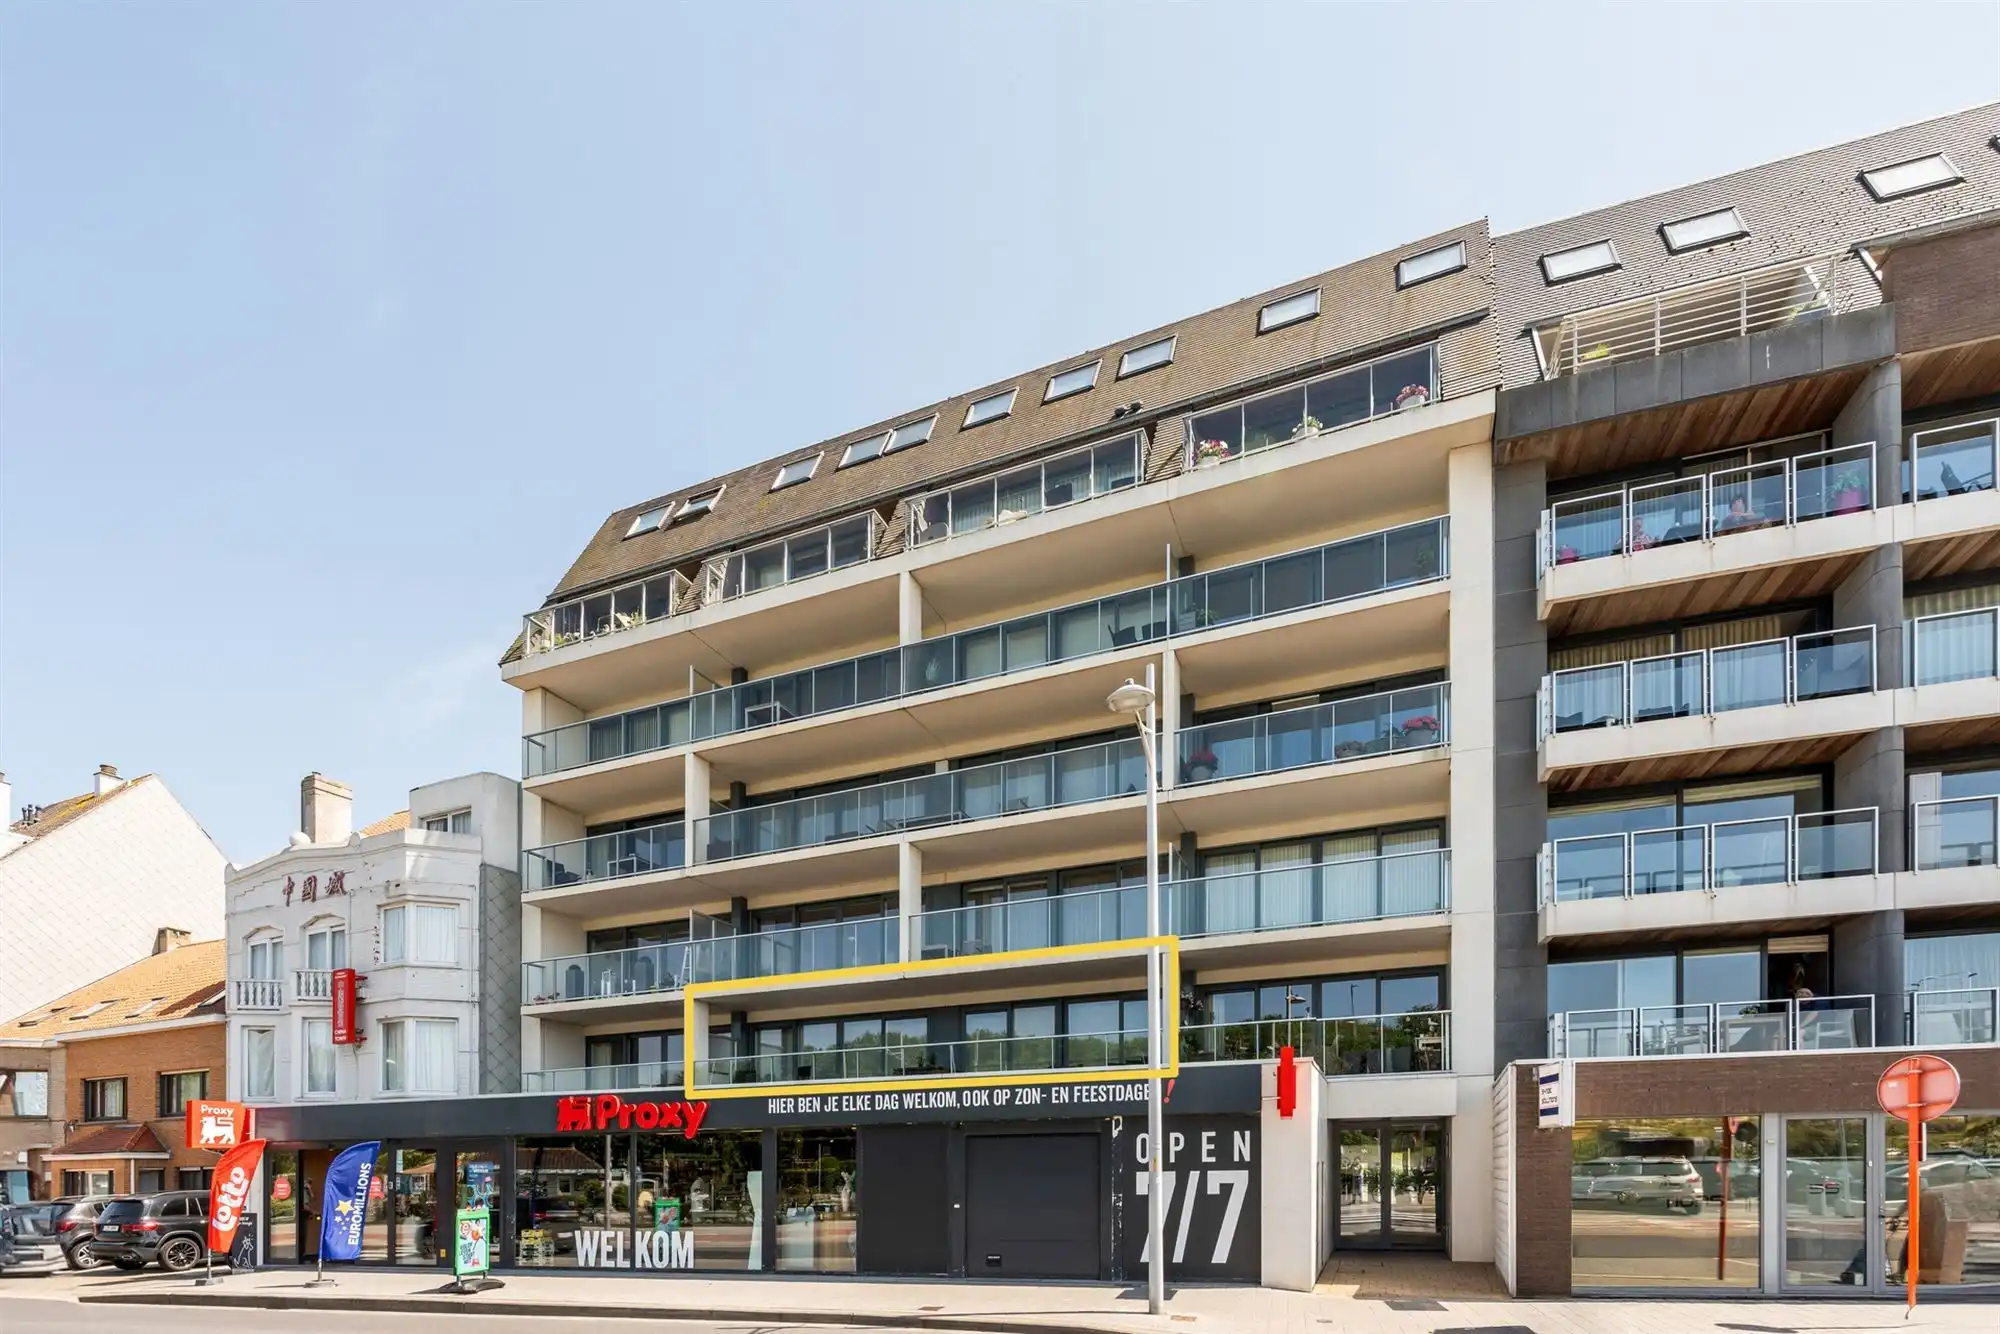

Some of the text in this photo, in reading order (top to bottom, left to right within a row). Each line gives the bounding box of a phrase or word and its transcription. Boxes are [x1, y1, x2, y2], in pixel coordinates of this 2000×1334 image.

[200, 1104, 235, 1117] Proxy
[597, 1094, 708, 1139] Proxy
[768, 1098, 794, 1114] HIER
[799, 1097, 821, 1113] BEN
[824, 1096, 839, 1112] JE
[842, 1094, 872, 1112] ELKE
[875, 1093, 899, 1110] DAG
[902, 1090, 960, 1110] WELKOM,
[962, 1089, 990, 1107] OOK
[993, 1088, 1011, 1106] OP
[1014, 1087, 1047, 1106] ZON-
[1051, 1086, 1069, 1104] EN
[1135, 1130, 1251, 1164] OPEN
[212, 1166, 250, 1232] Lotto
[347, 1162, 372, 1246] EUROMILLIONS
[1135, 1170, 1249, 1264] 7/7
[574, 1230, 694, 1269] WELKOM
